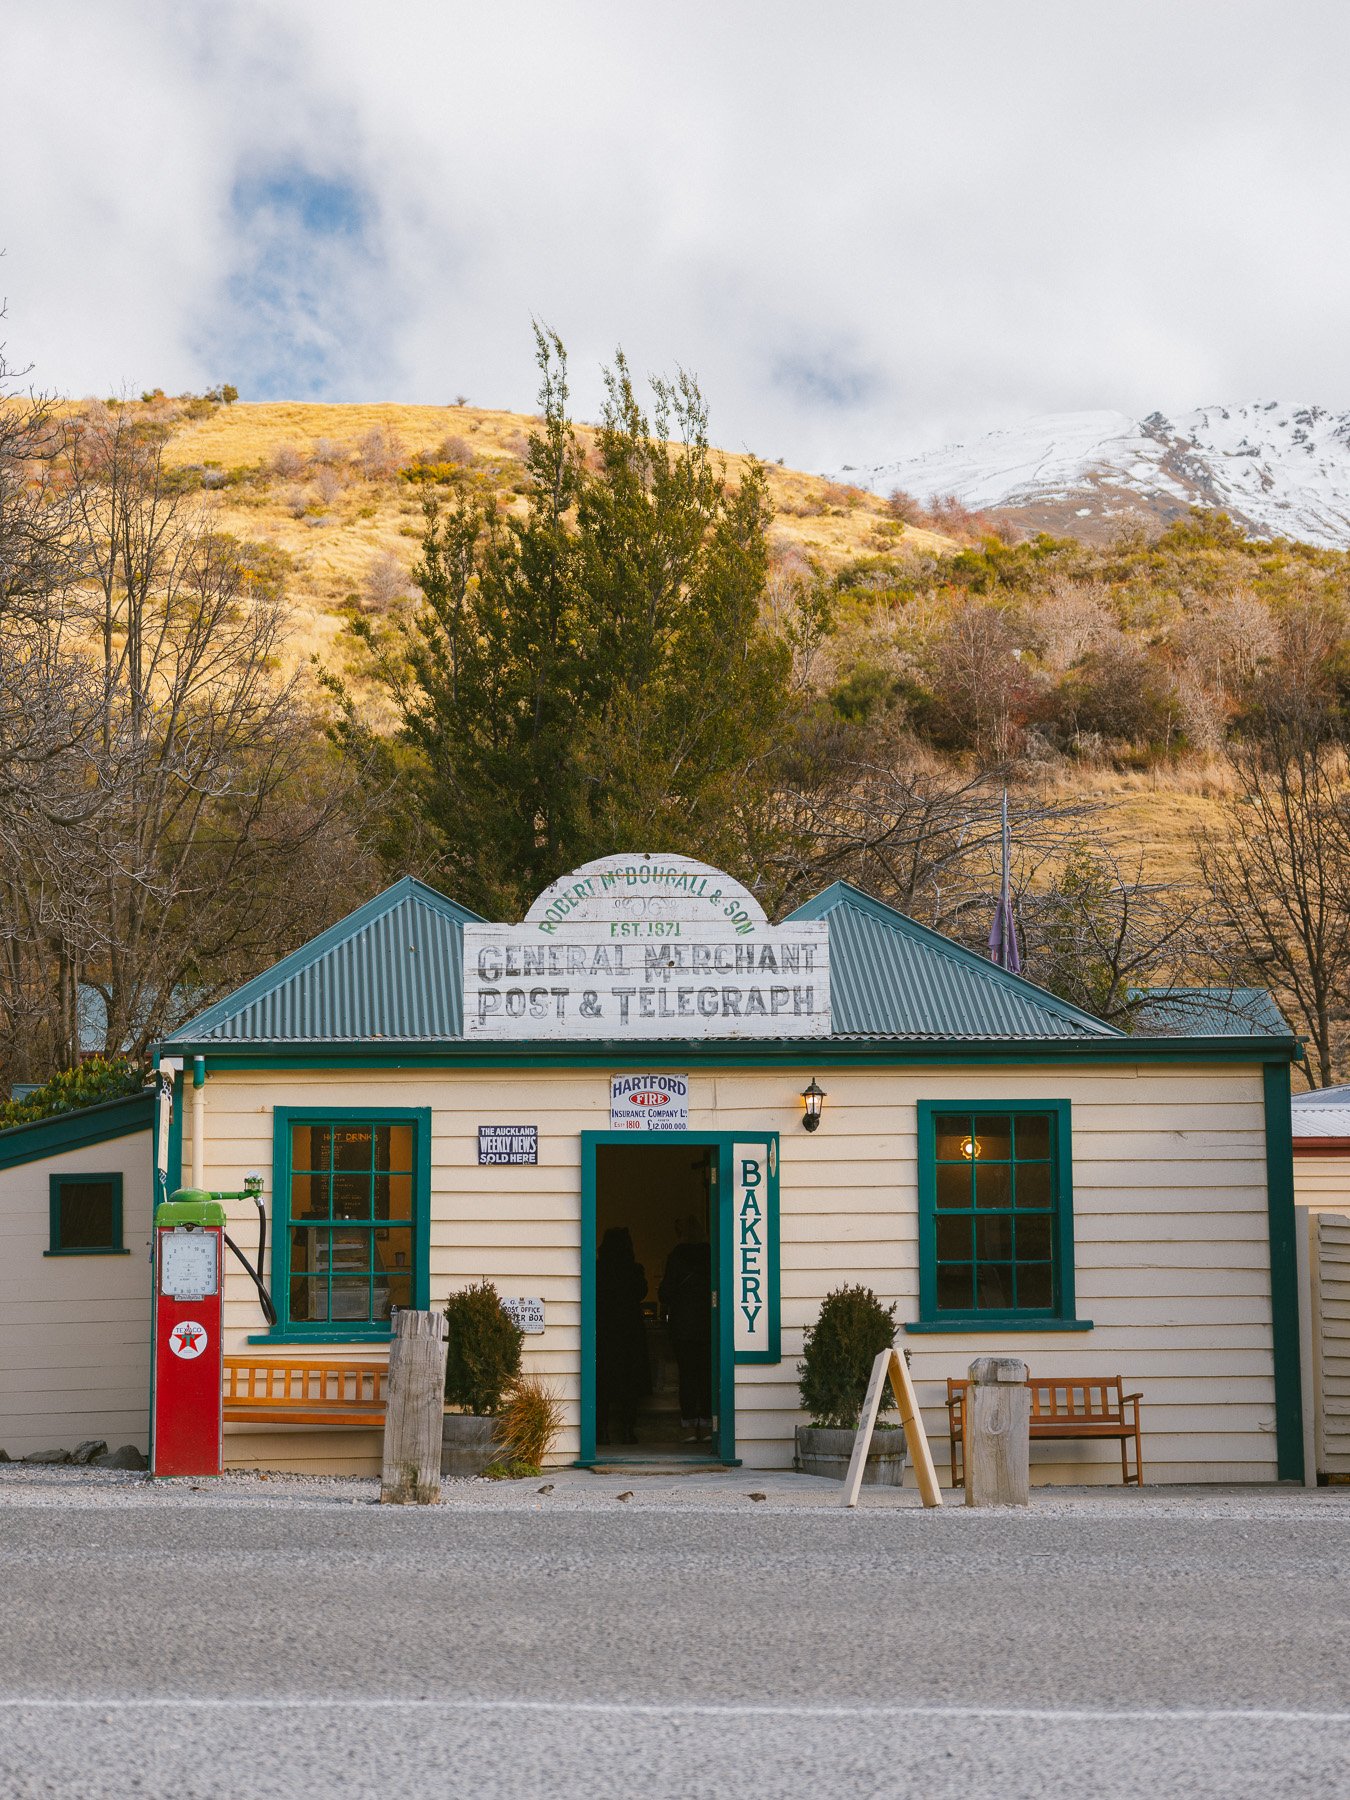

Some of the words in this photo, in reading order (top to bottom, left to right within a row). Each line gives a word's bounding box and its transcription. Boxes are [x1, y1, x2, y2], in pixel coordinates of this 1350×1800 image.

[538, 877, 597, 935] ROBERT
[709, 889, 723, 907] &
[723, 901, 755, 937] SON
[477, 945, 631, 983] GENERAL
[644, 944, 818, 983] MERCHANT
[477, 987, 569, 1026] POST
[579, 989, 605, 1019] &
[611, 986, 814, 1026] TELEGRAPH
[613, 1075, 686, 1098] HARTFORD
[636, 1092, 665, 1105] FIRE
[612, 1108, 646, 1118] INSURANCE
[647, 1108, 679, 1118] COMPANY
[481, 1127, 495, 1136] THE
[495, 1127, 535, 1136] AUCKLAND
[480, 1136, 511, 1153] WEEKLY
[512, 1136, 537, 1153] NEWS
[480, 1154, 509, 1163] SOLD
[510, 1154, 536, 1163] HERE
[740, 1159, 762, 1333] BAKERY
[528, 1314, 543, 1322] BOX
